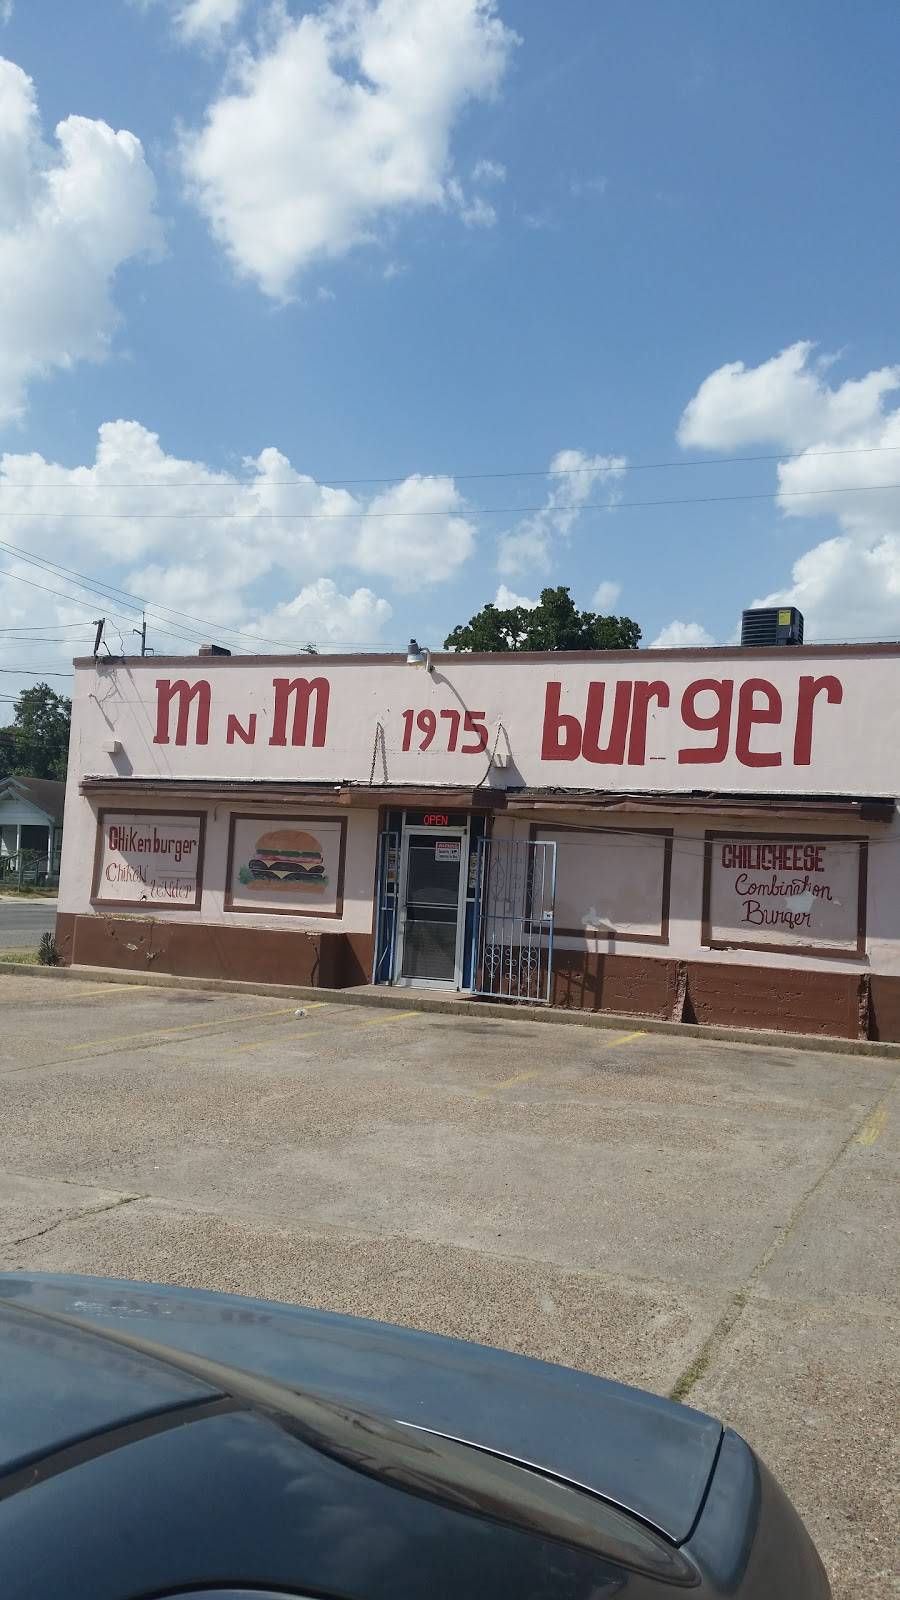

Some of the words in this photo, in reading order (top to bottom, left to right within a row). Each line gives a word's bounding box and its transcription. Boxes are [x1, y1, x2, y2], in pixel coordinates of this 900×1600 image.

[401, 709, 489, 754] 1975
[541, 675, 843, 768] burger
[423, 814, 449, 826] OPEN
[735, 873, 833, 901] Combination
[741, 900, 811, 930] Burger
